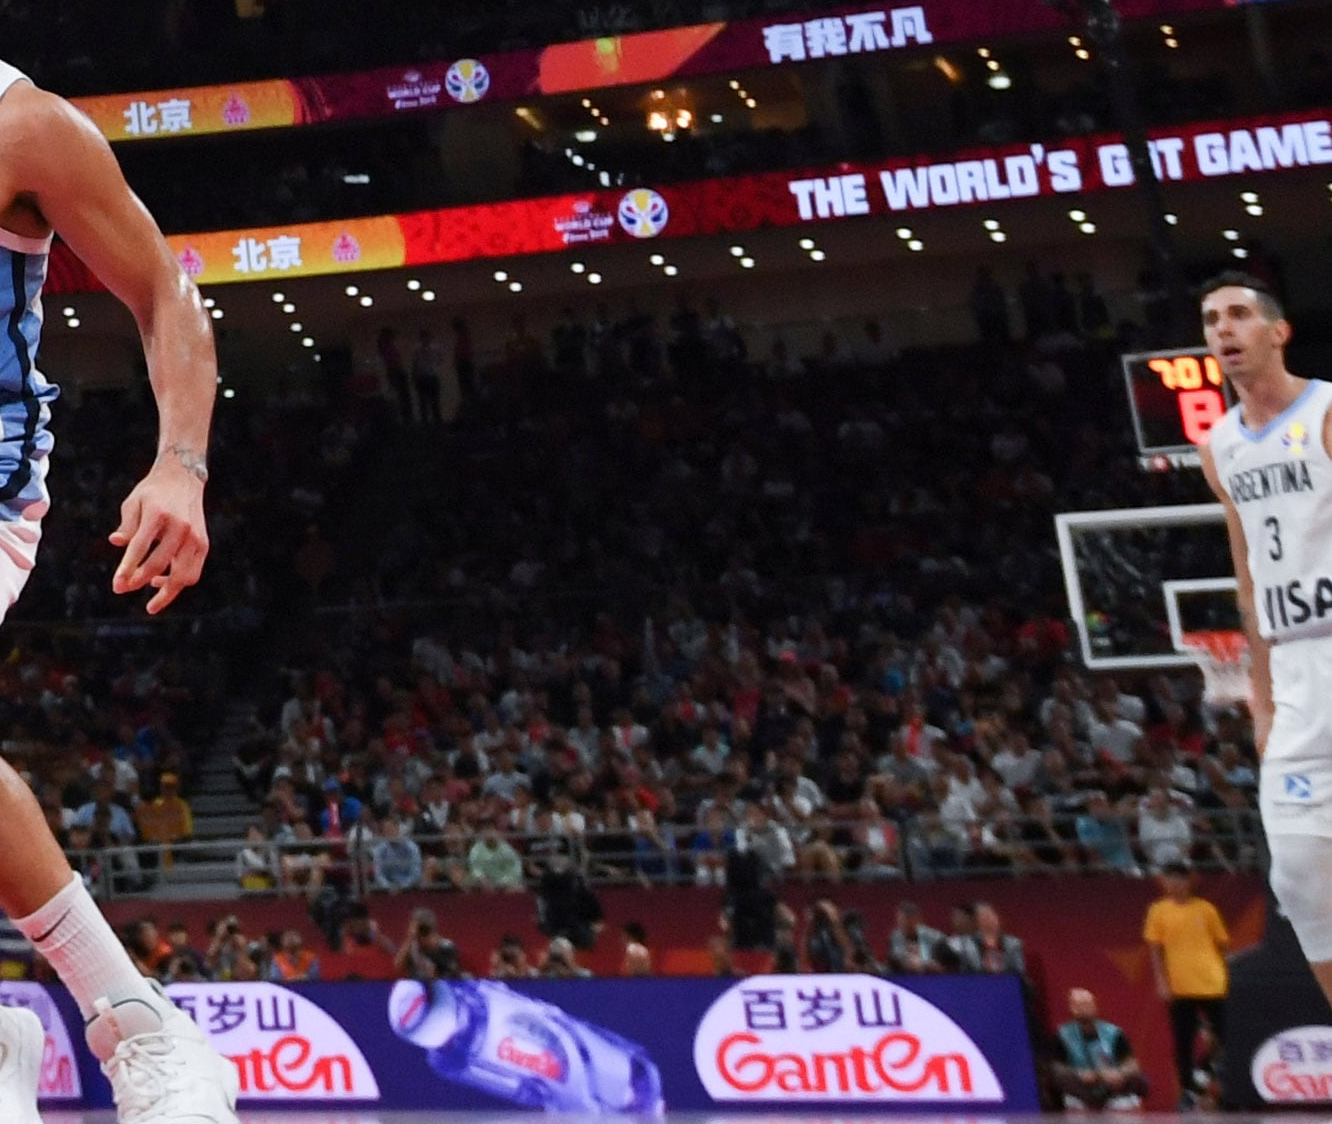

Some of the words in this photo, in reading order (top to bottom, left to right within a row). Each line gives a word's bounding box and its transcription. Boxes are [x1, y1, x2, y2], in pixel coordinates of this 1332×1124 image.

[762, 5, 934, 64] 有我不凡
[123, 98, 192, 135] 北京
[788, 174, 870, 220] THE
[879, 142, 1082, 210] WORLD'S
[1193, 120, 1332, 176] GAME
[232, 235, 303, 273] 北京
[1265, 516, 1283, 562] 3
[740, 988, 903, 1031] 百岁山
